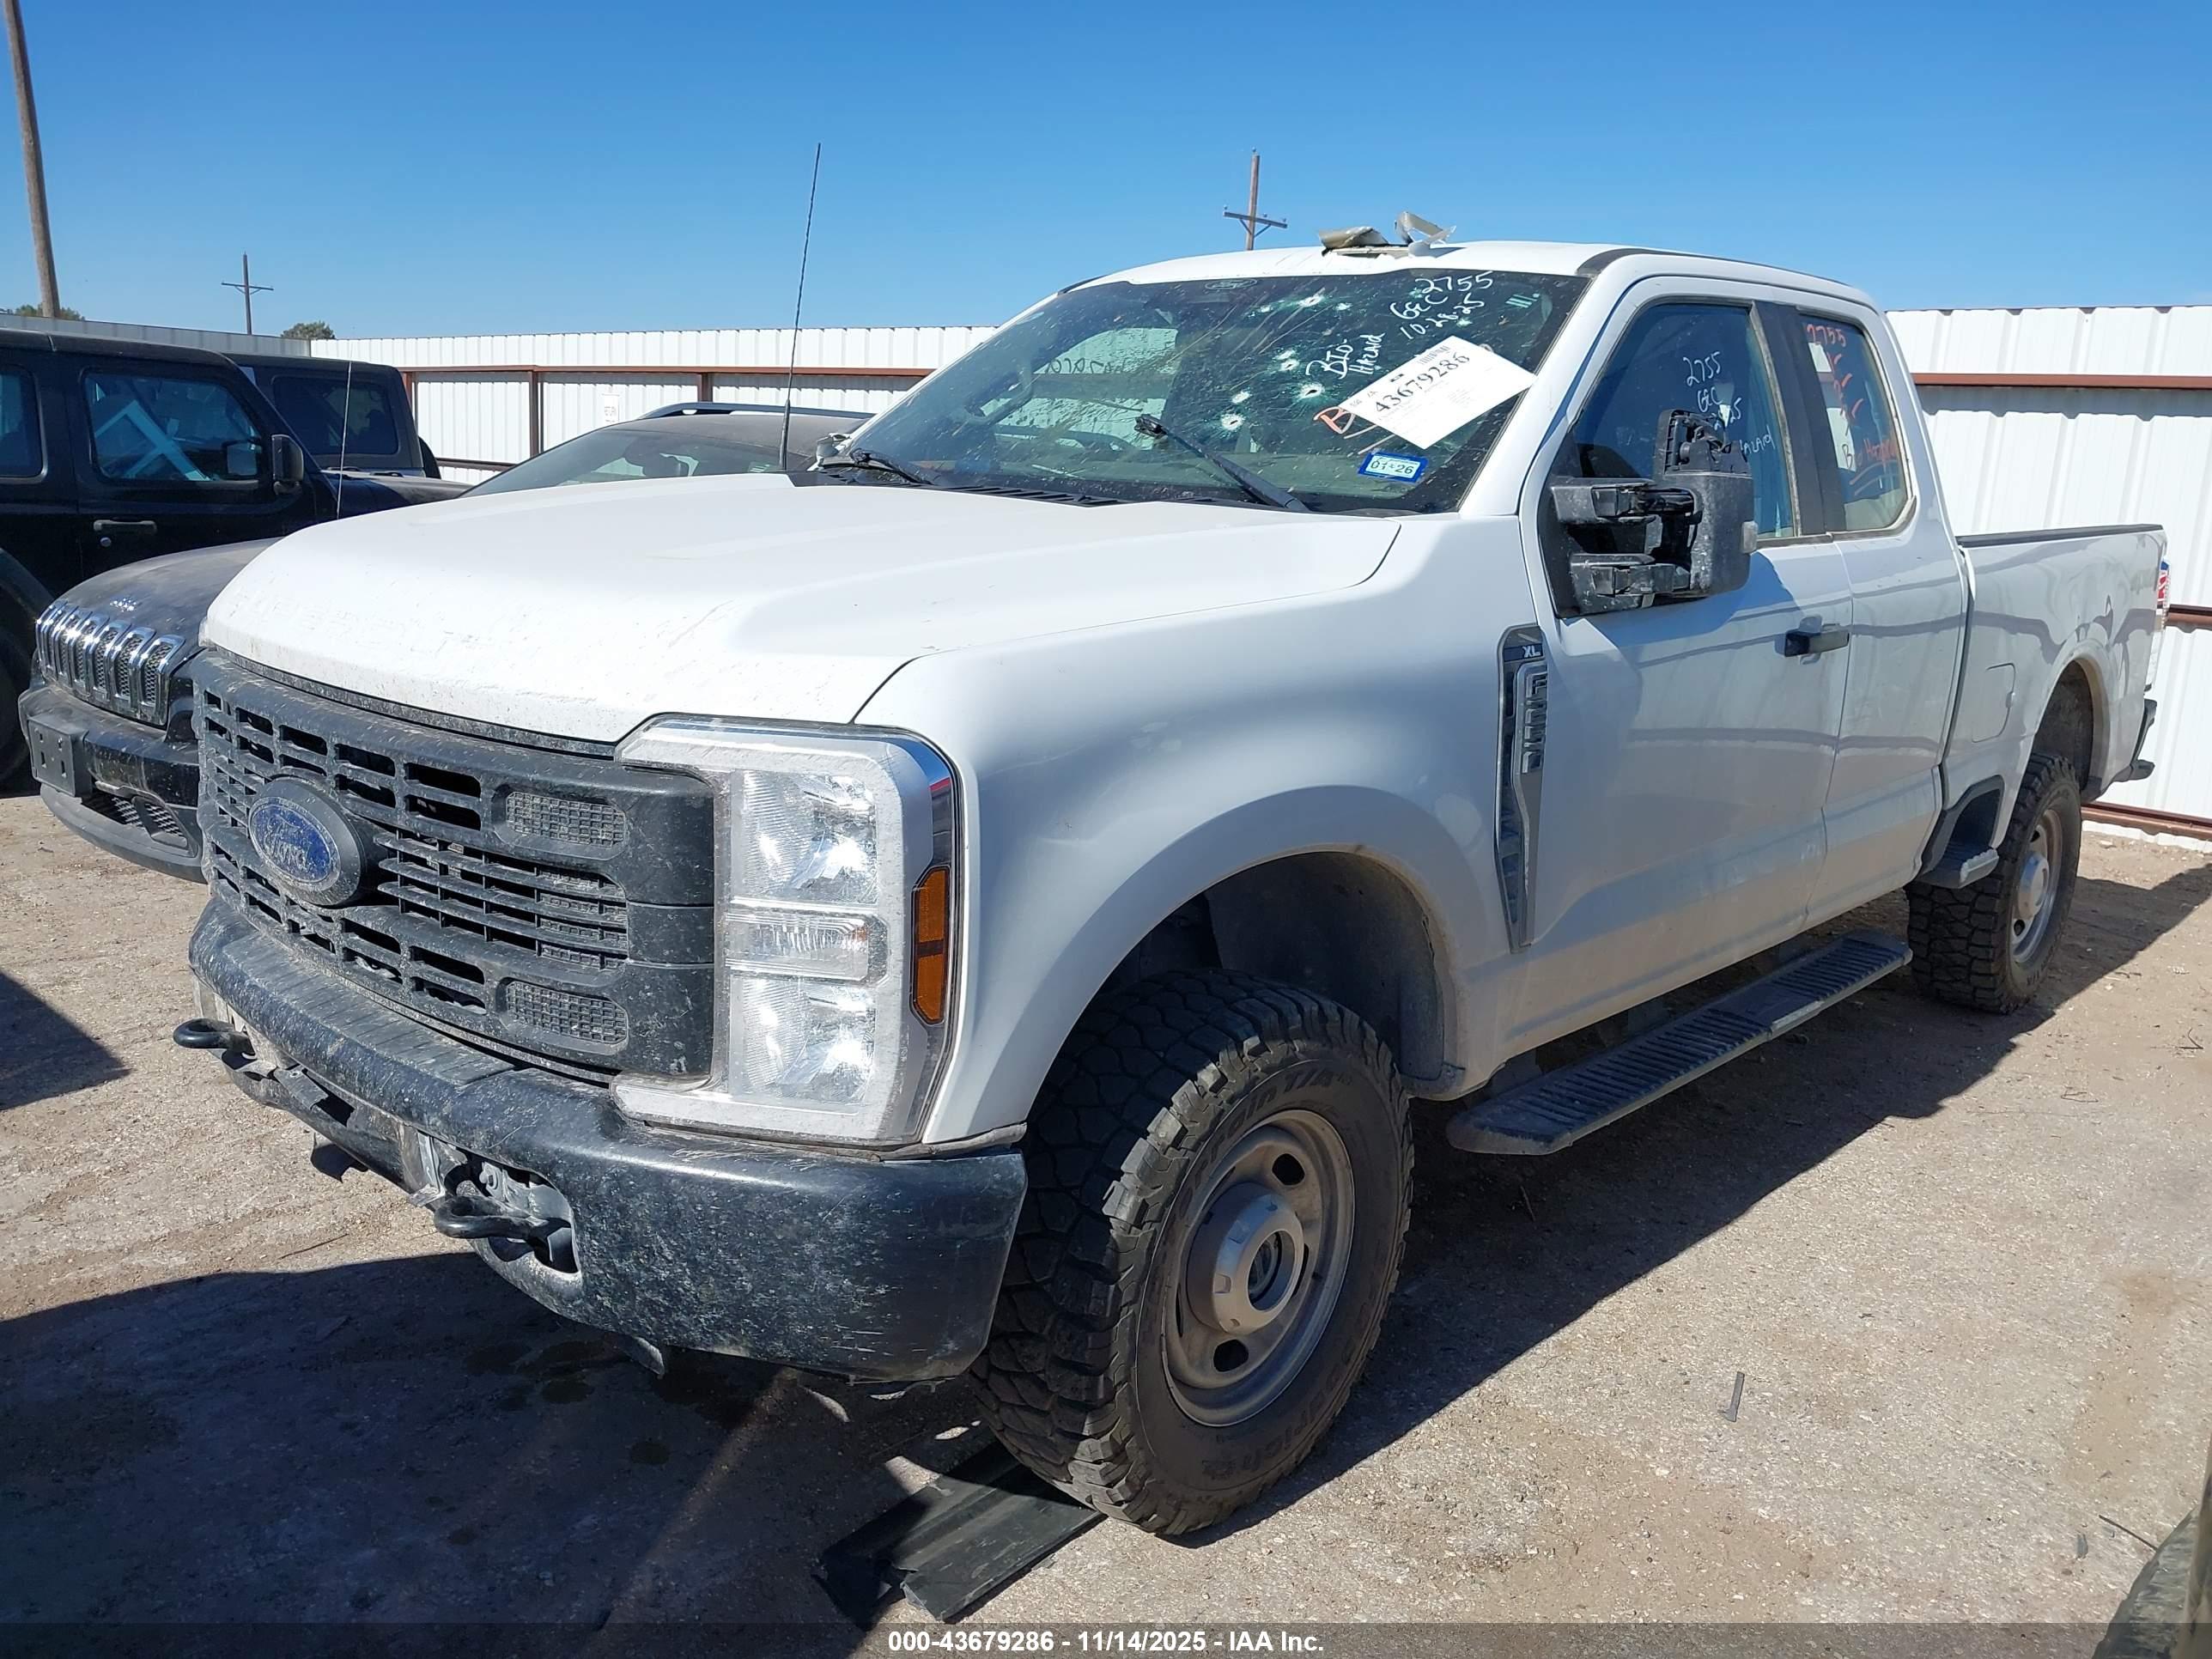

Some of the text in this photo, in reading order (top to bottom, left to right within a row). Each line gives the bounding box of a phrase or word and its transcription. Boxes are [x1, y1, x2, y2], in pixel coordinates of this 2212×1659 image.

[1414, 270, 1493, 294] 2755
[1376, 352, 1470, 412] 43679286
[1683, 351, 1721, 387] 2755
[1522, 645, 1541, 659] XL
